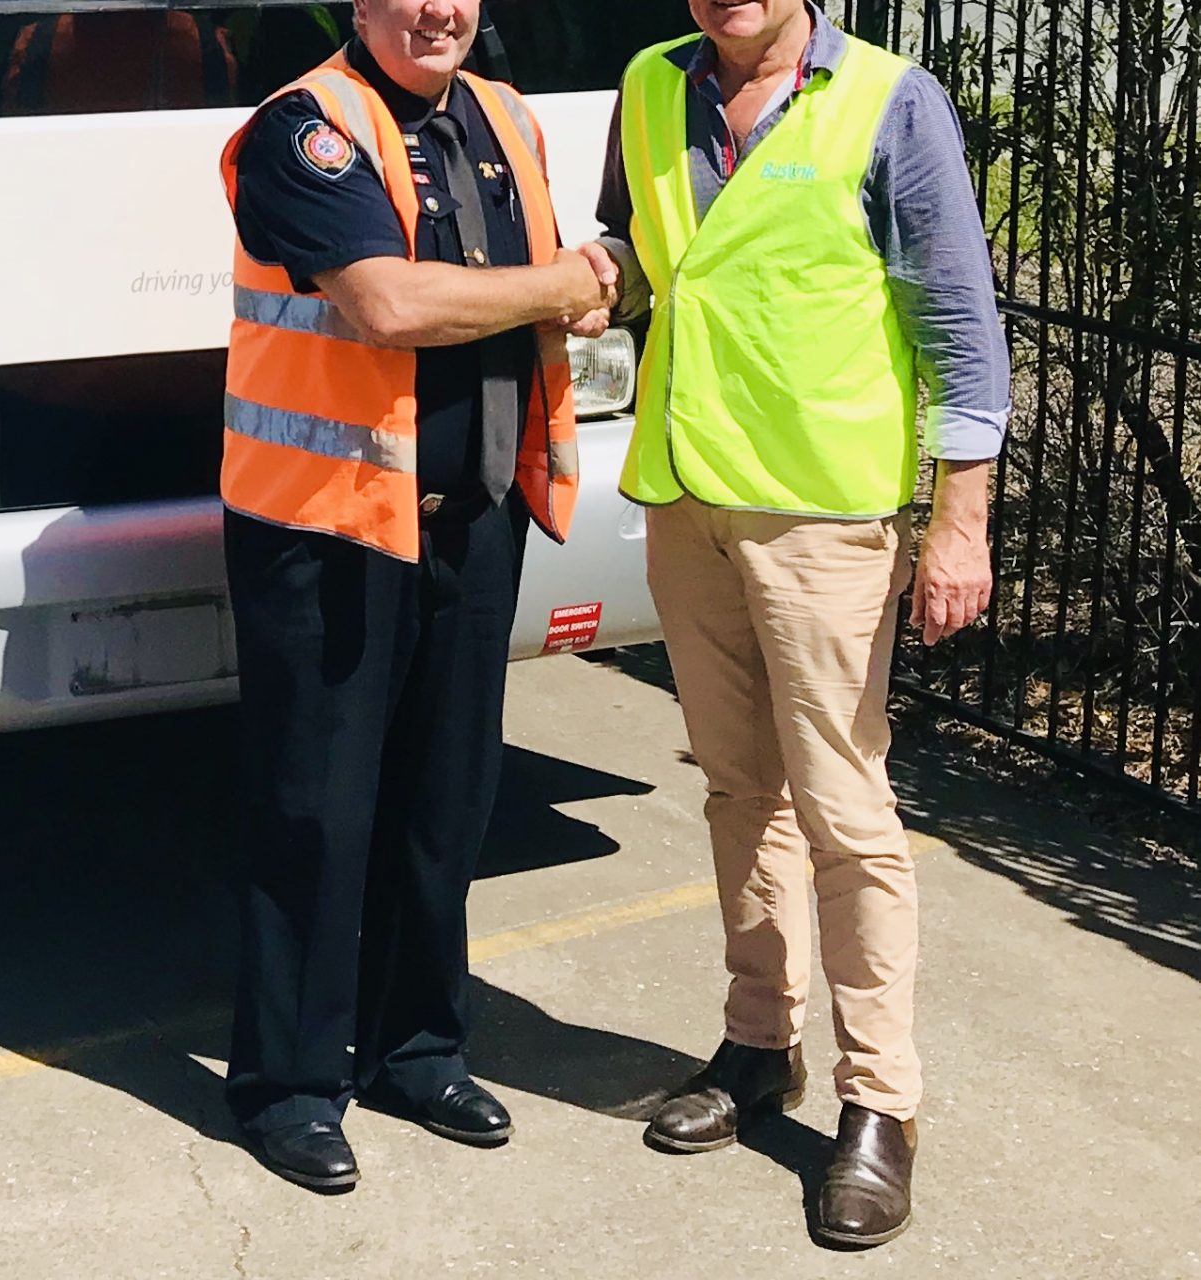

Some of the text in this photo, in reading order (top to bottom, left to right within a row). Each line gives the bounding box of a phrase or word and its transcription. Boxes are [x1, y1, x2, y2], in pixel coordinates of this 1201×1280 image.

[760, 160, 816, 180] Buslink
[130, 269, 204, 296] driving
[553, 605, 598, 619] EMERGENCY
[548, 620, 598, 634] DOOR SWITCH
